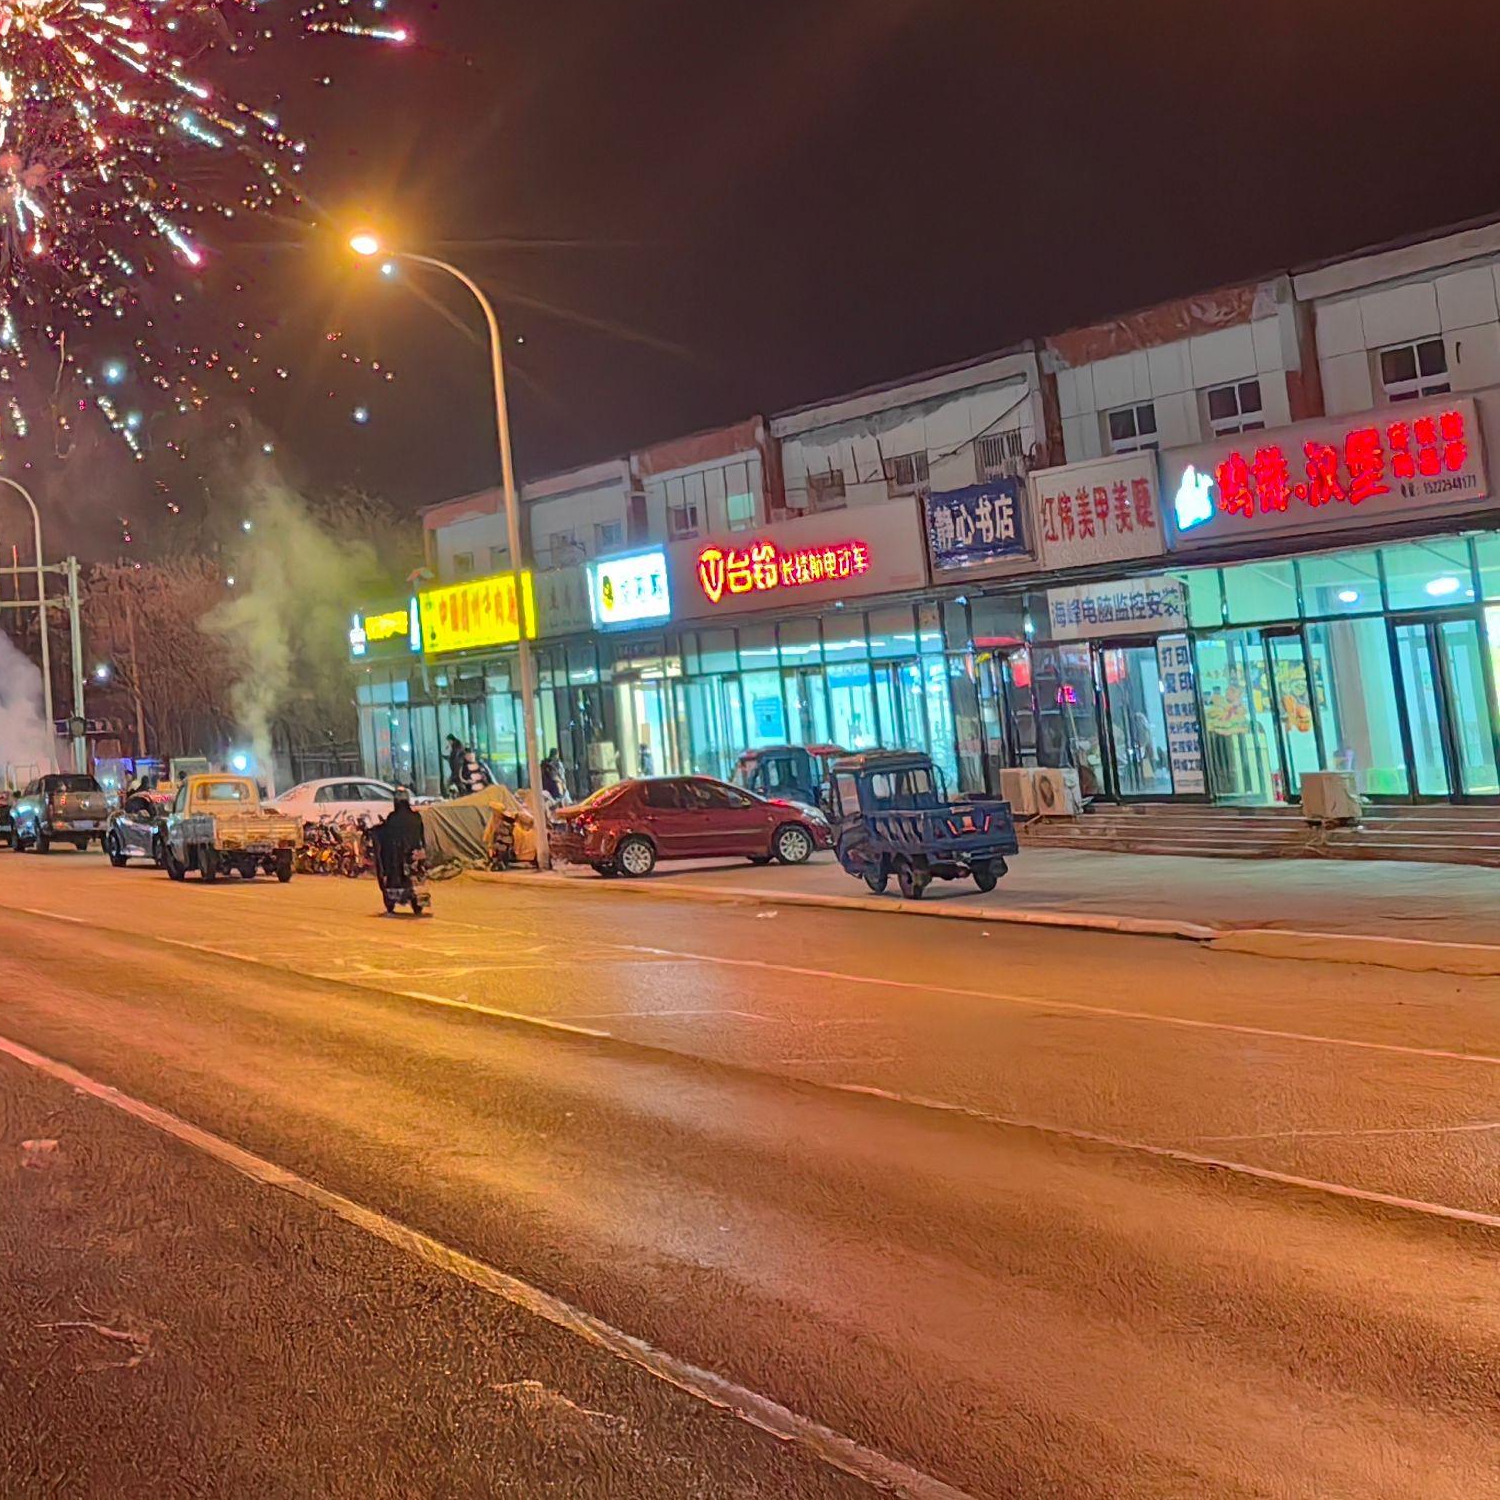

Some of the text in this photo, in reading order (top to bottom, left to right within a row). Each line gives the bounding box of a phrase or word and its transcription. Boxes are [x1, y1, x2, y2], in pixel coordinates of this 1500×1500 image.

[933, 493, 1016, 549] 静心书店
[727, 542, 779, 593] 台铃
